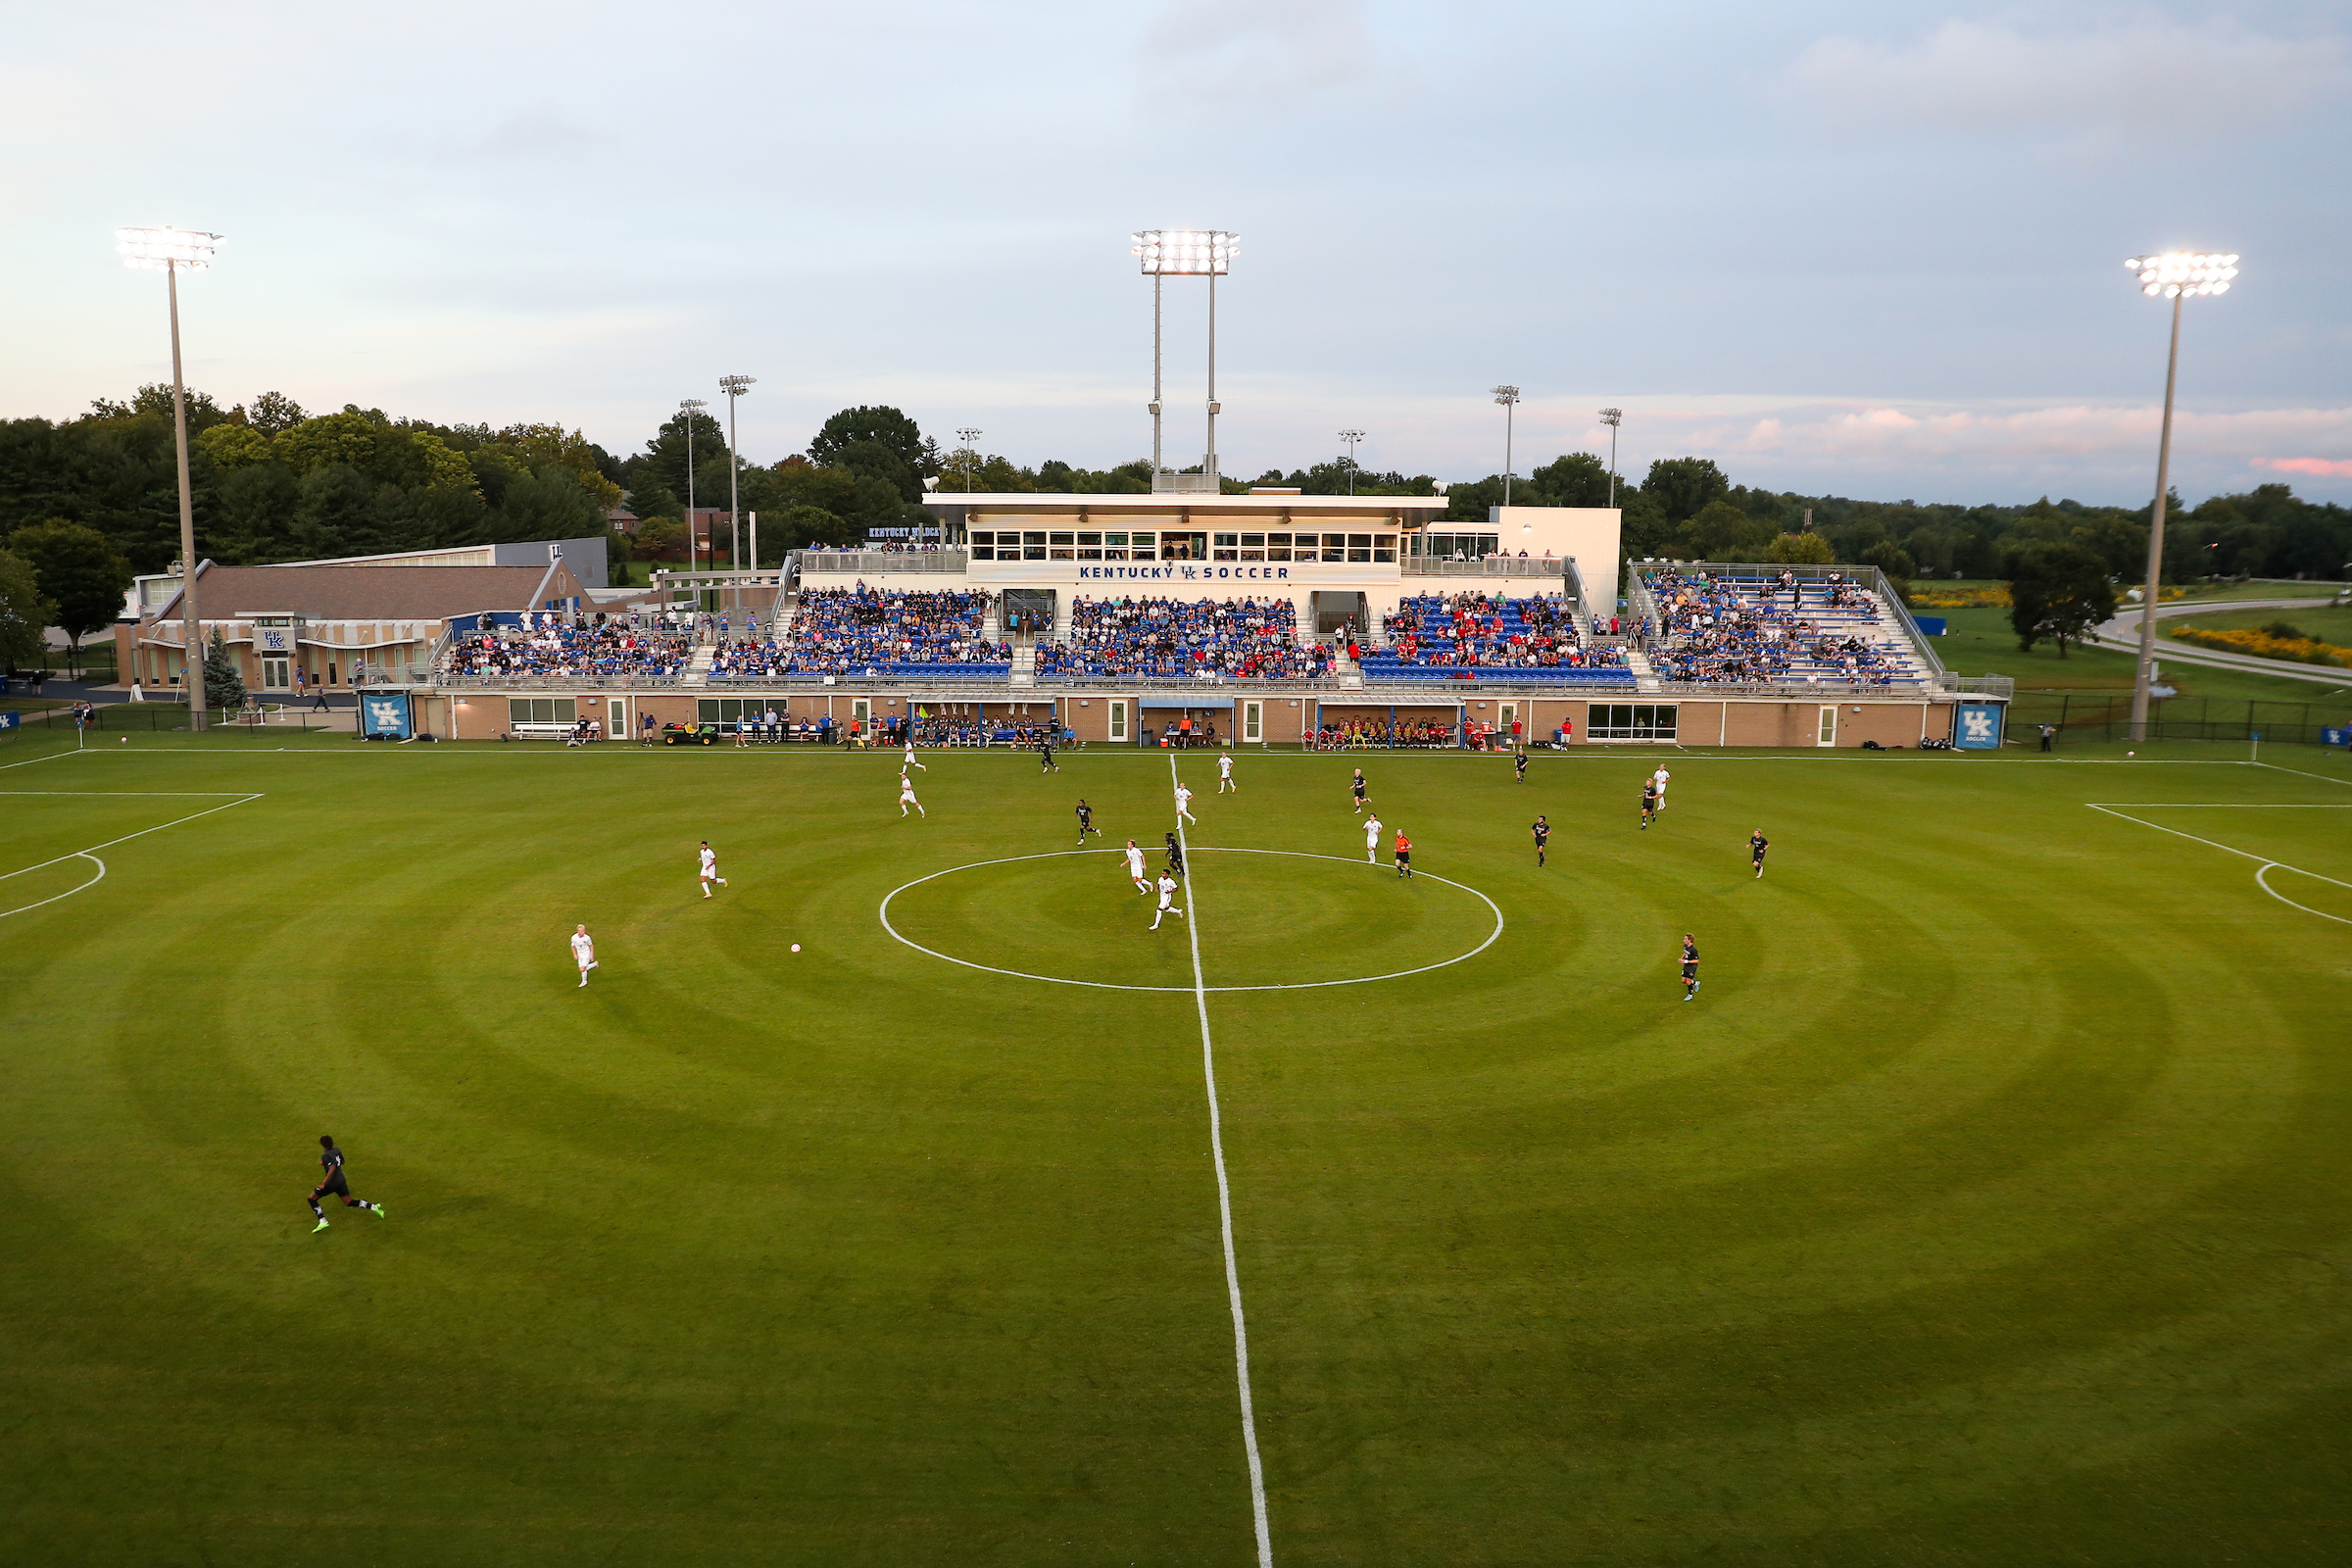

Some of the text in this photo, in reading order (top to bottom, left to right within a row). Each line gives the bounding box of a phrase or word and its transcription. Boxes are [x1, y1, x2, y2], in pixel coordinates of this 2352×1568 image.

[868, 527, 948, 537] KENTUCKY WLDCAS
[1080, 566, 1173, 578] KENTUCKY
[1203, 567, 1289, 578] SOCCER
[264, 630, 284, 649] UK
[370, 702, 404, 726] UK
[1963, 710, 1993, 736] UK
